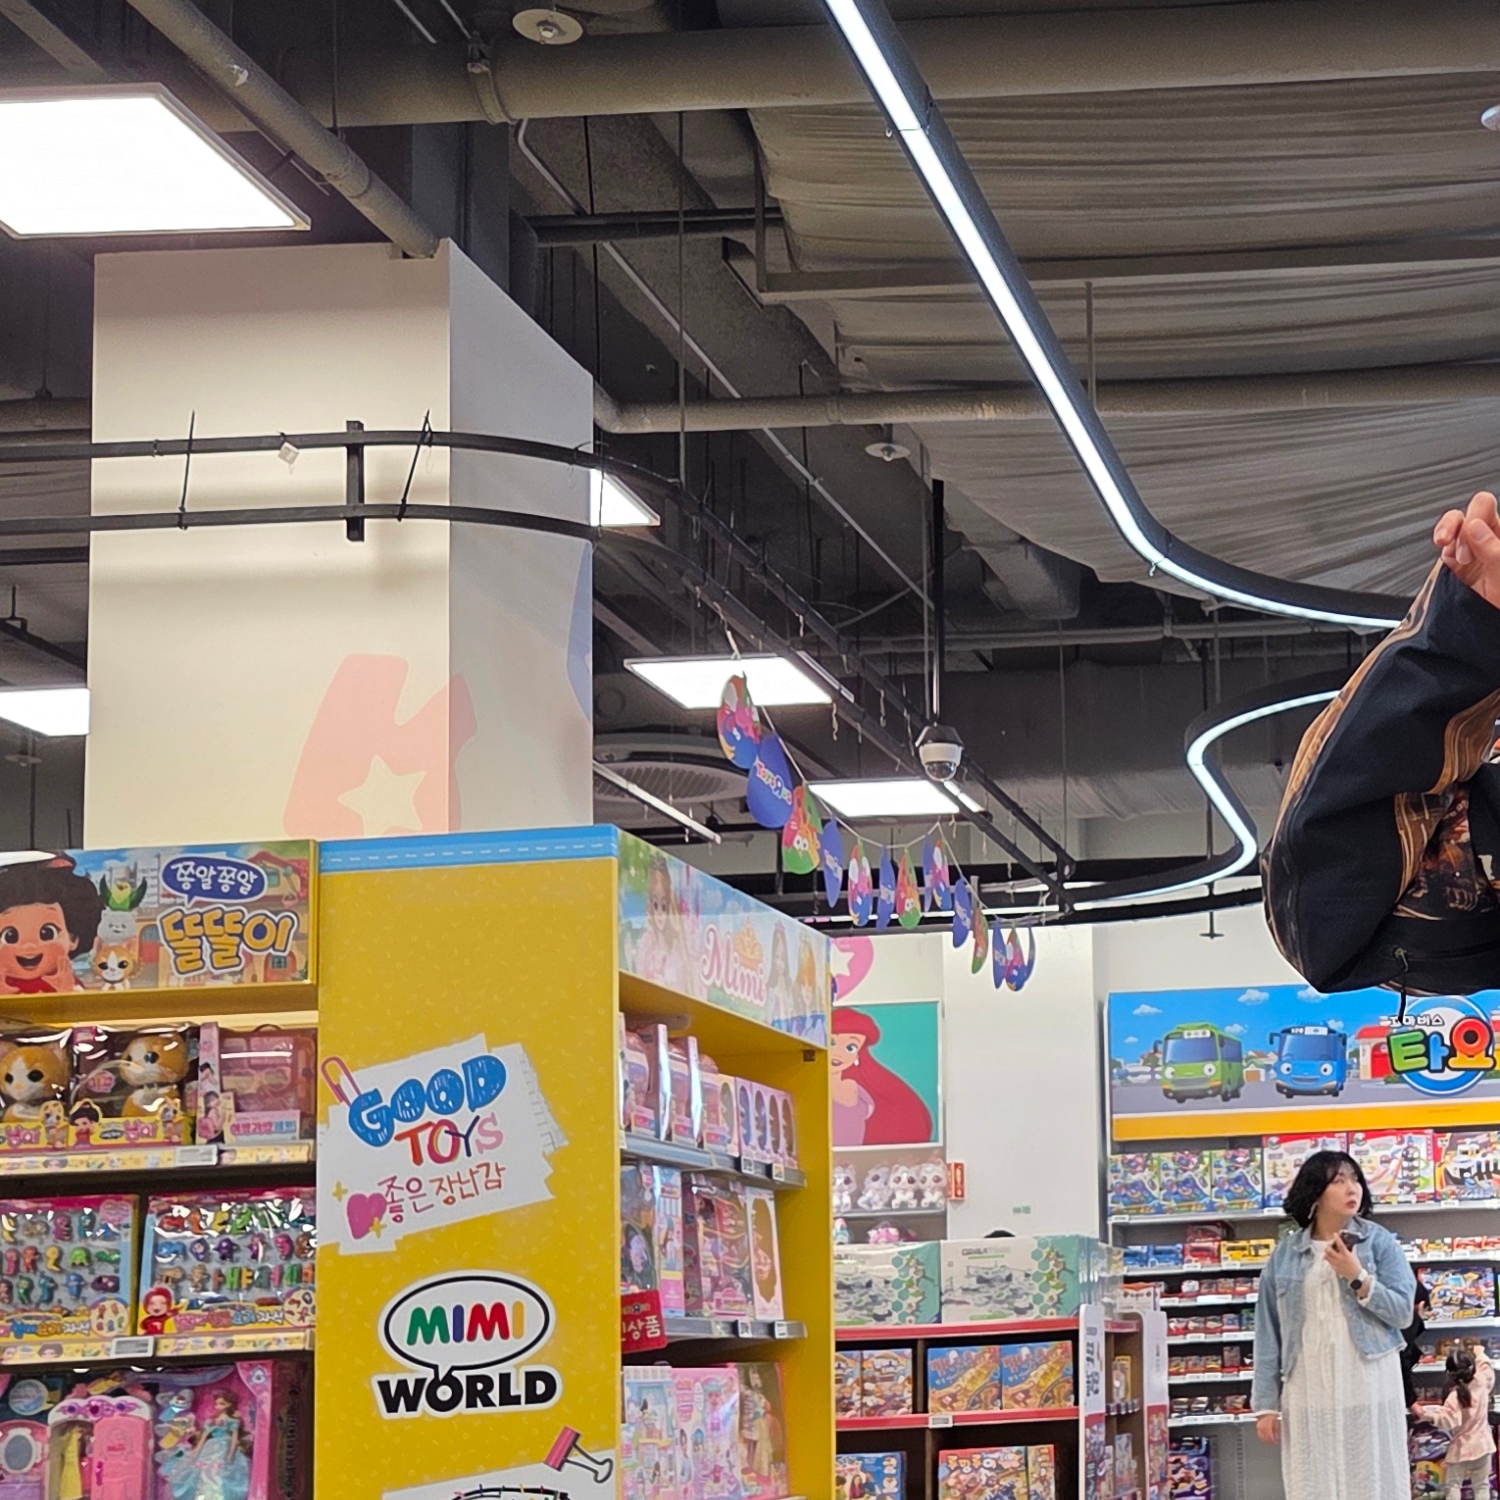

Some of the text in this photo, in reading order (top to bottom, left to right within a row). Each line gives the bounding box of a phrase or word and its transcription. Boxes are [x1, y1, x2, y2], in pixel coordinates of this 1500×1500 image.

[170, 860, 259, 896] 쫑알쫑알
[161, 907, 295, 974] 똘똘이
[701, 924, 766, 1004] Mimi
[1388, 1016, 1497, 1074] 타요
[349, 1055, 507, 1147] GOOD
[394, 1112, 505, 1166] TOYS
[378, 1162, 507, 1223] 좋은 장난감
[406, 1301, 524, 1345] MIMI
[377, 1370, 557, 1414] WORLD
